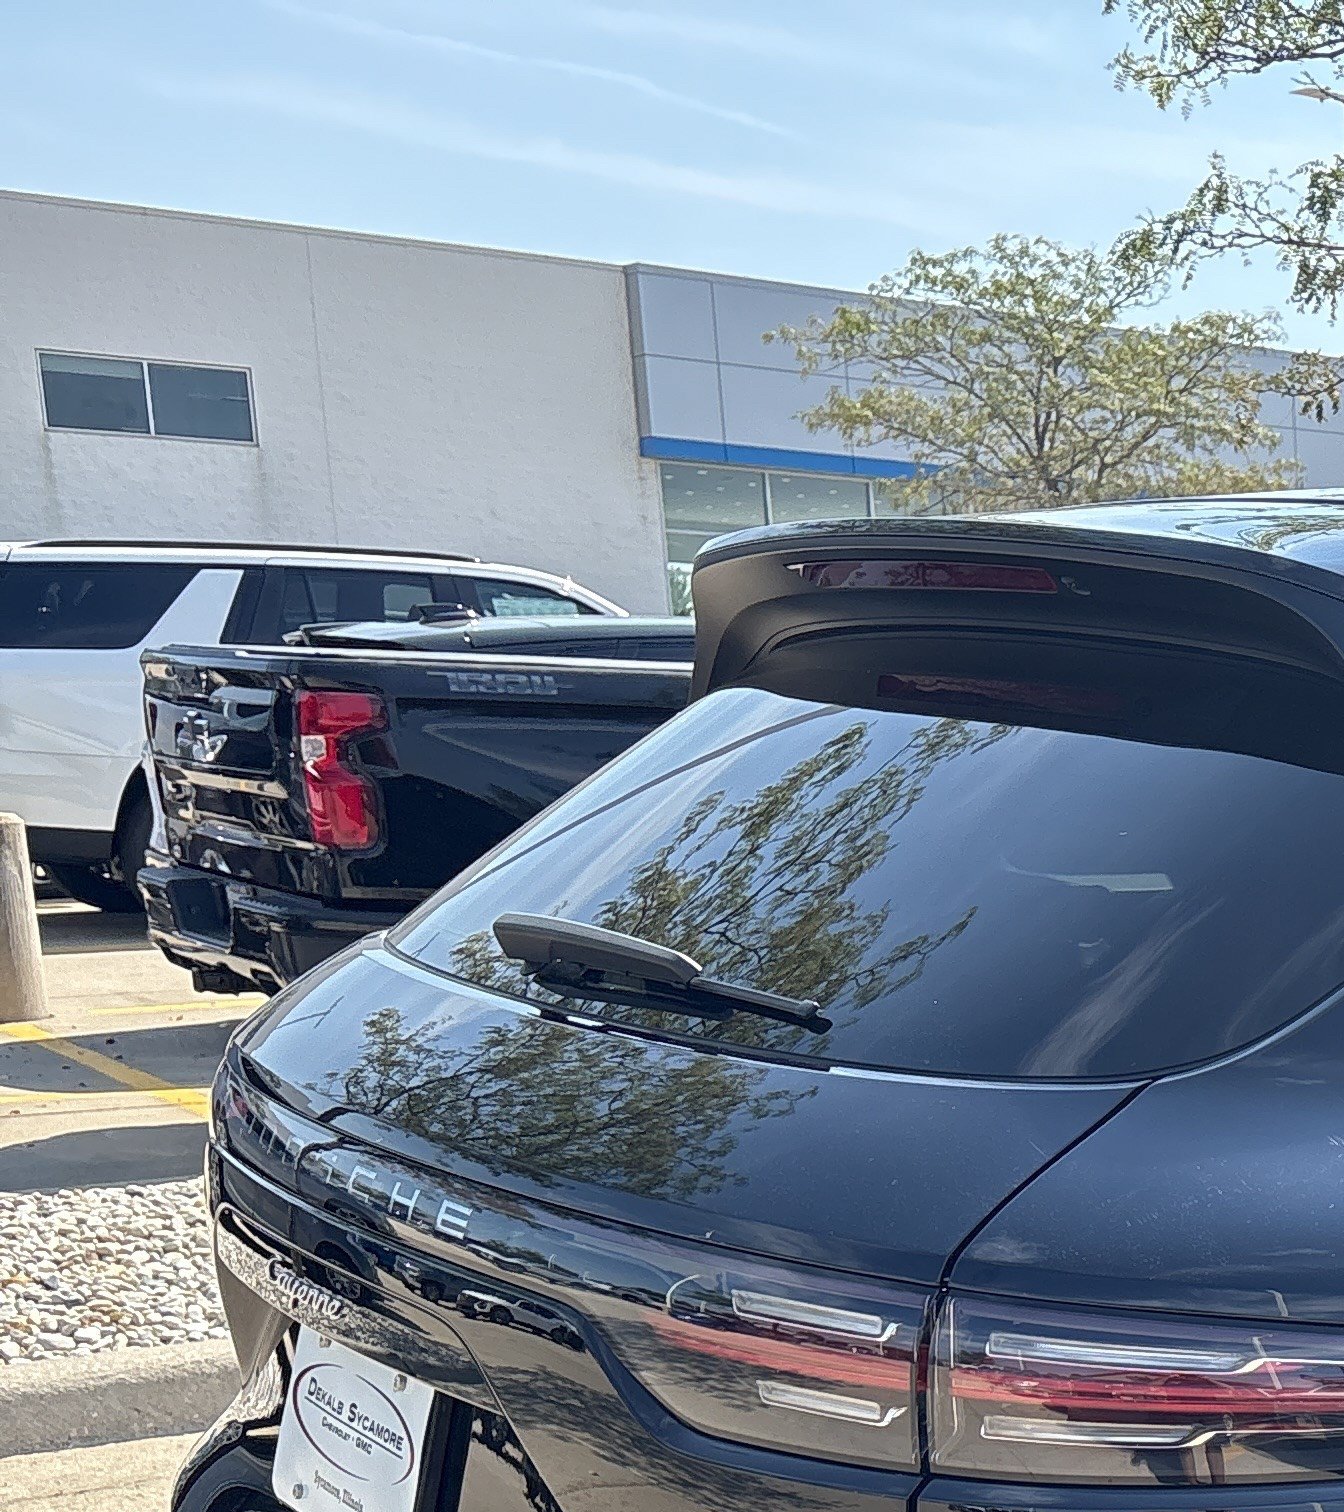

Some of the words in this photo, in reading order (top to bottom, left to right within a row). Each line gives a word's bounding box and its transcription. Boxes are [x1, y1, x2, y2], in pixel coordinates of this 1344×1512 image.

[265, 1257, 342, 1320] Cayenne
[347, 1402, 405, 1452] SYCAMORE
[355, 1436, 373, 1456] GMC
